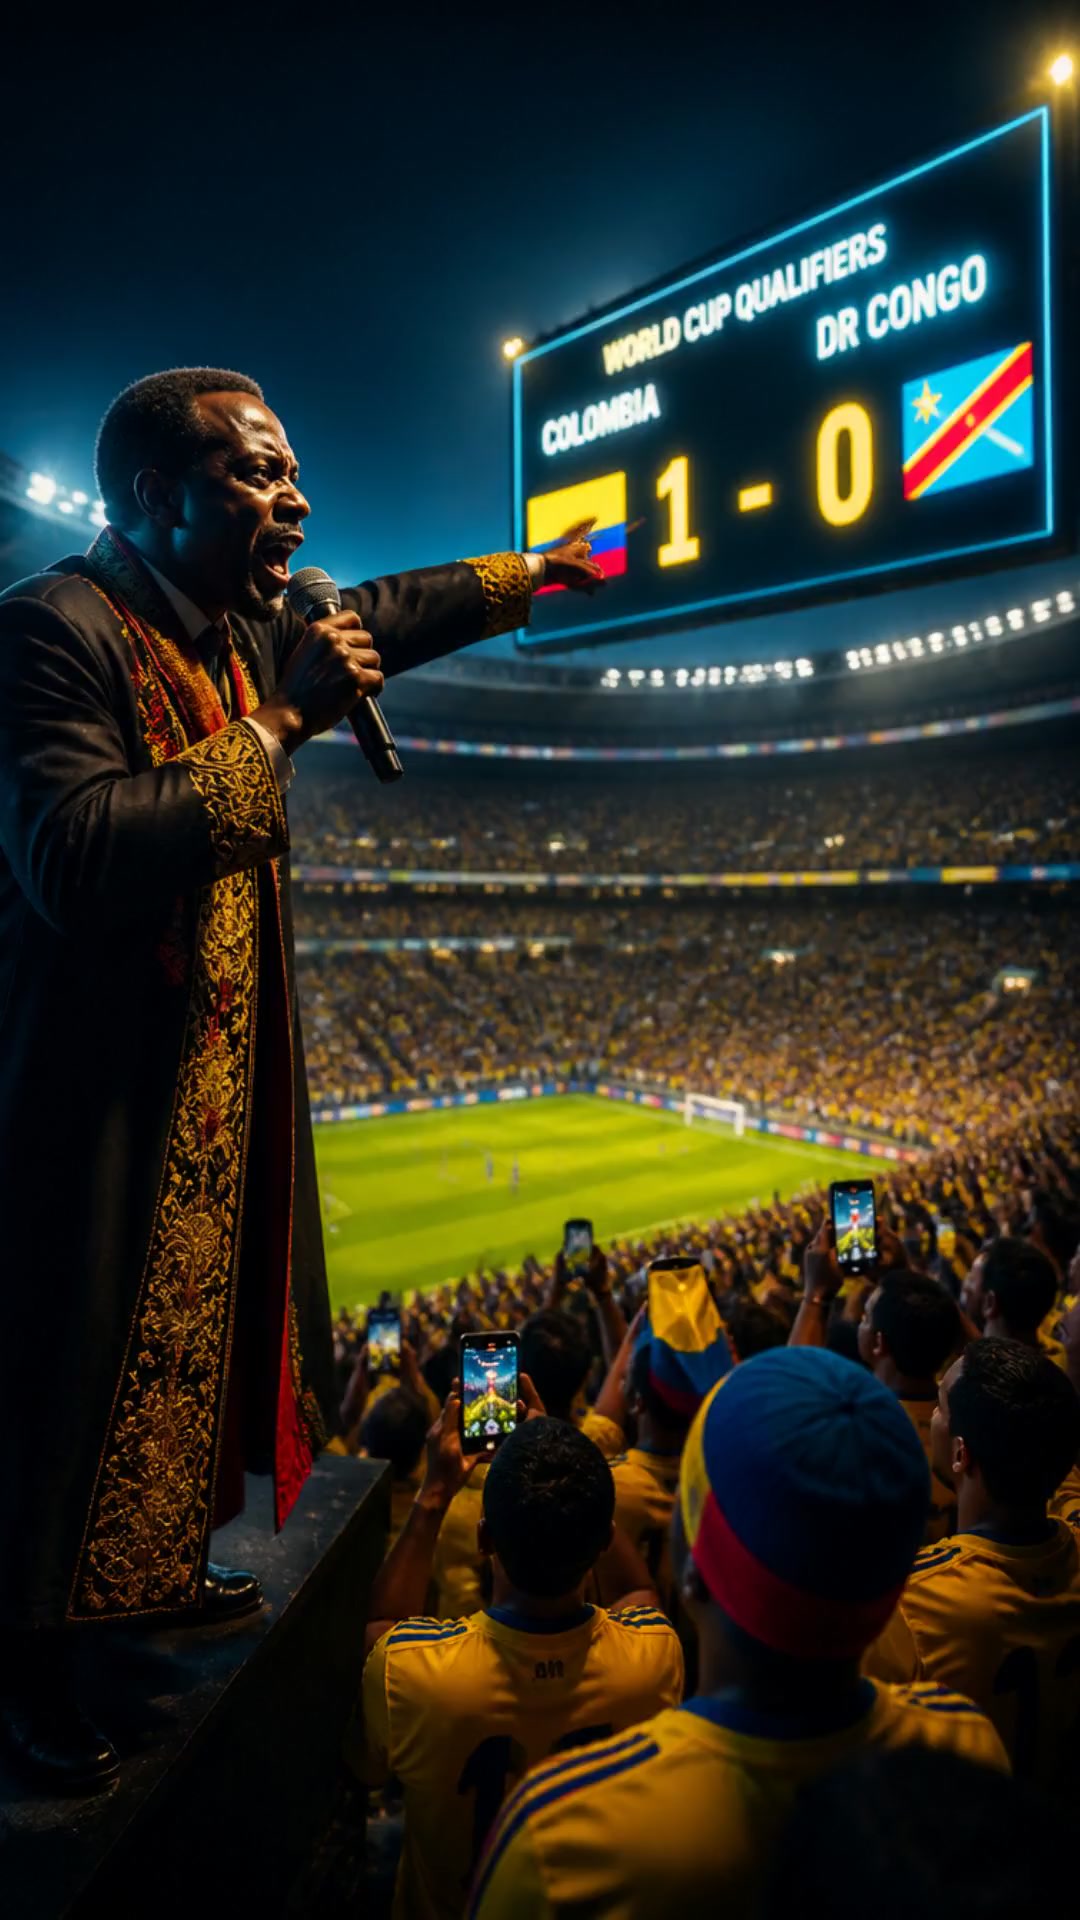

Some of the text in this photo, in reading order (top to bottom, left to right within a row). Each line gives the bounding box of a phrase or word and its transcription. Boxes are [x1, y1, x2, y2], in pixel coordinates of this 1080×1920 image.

[602, 223, 888, 376] WORLD CUP QUALIFIERS
[816, 254, 987, 360] DR CONGO
[541, 383, 662, 456] COLOMBIA
[656, 455, 700, 568] 1
[816, 401, 874, 527] 0
